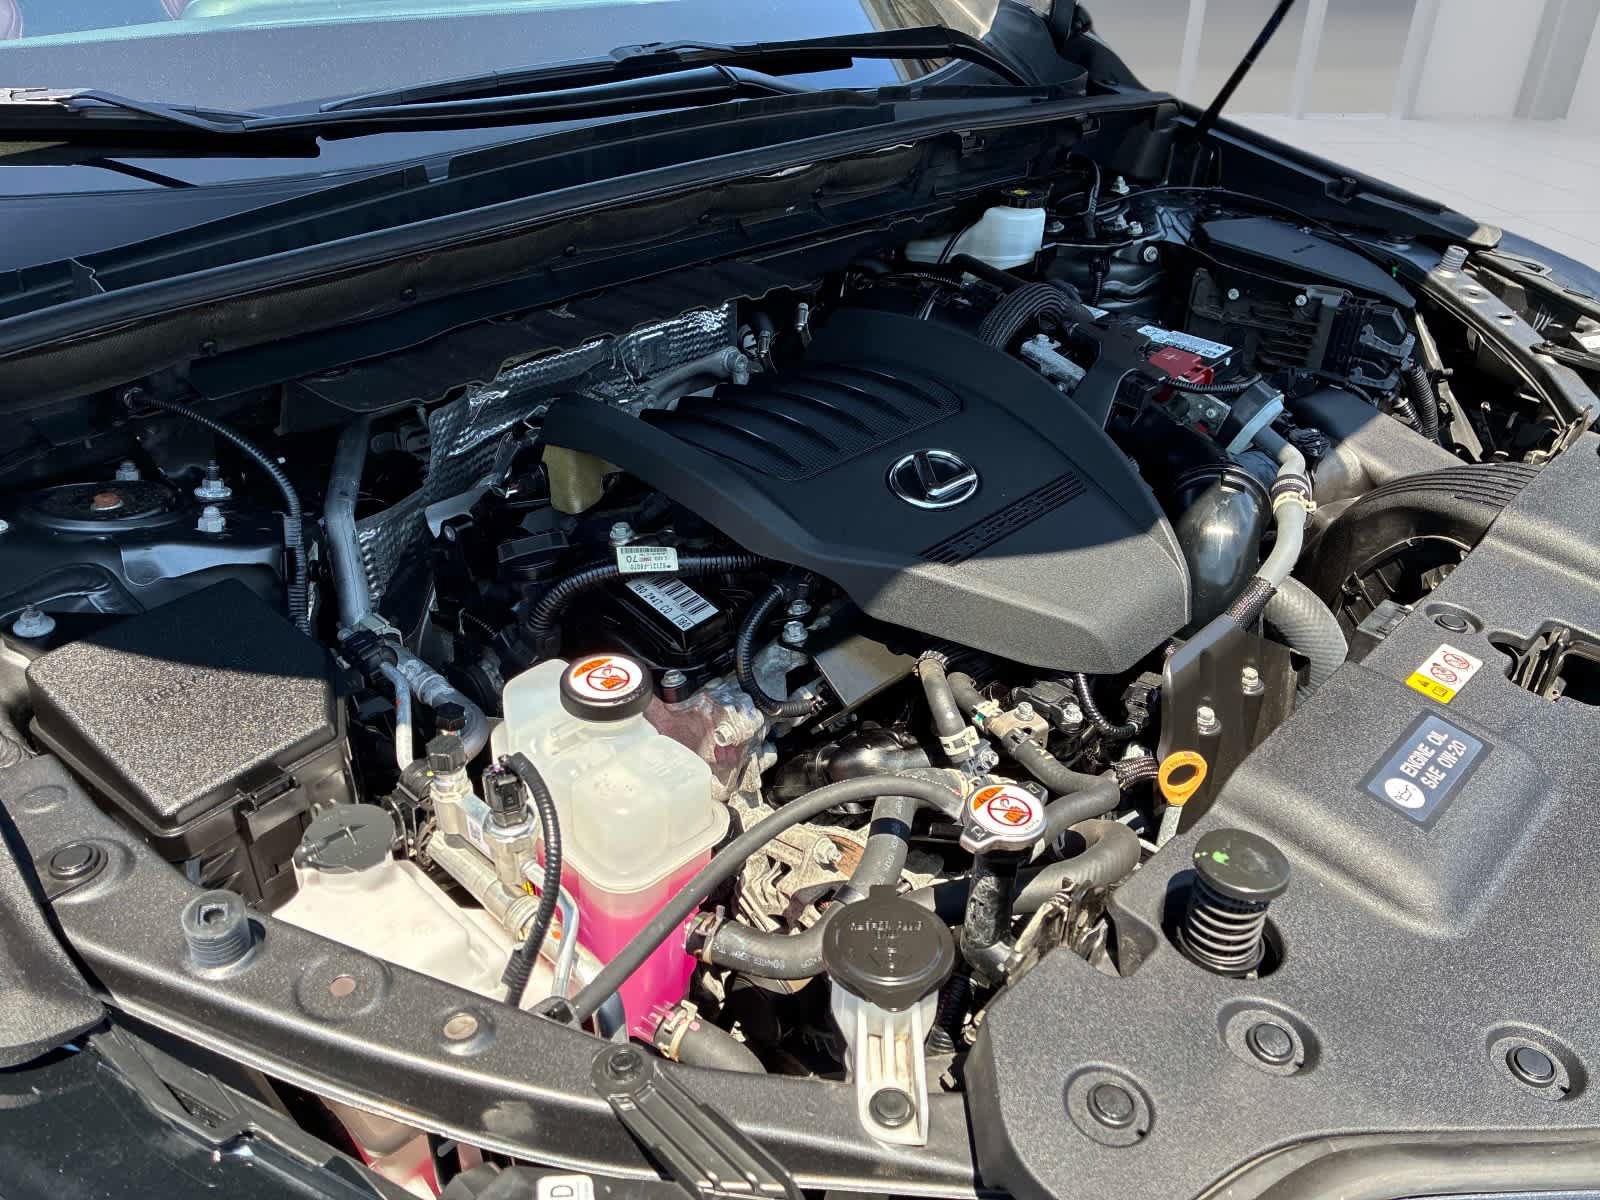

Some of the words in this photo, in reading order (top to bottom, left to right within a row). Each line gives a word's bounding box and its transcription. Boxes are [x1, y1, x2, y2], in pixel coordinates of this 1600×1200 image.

[1400, 743, 1436, 778] ENGINE
[1426, 730, 1449, 746] OIL
[1420, 765, 1447, 789] SAE
